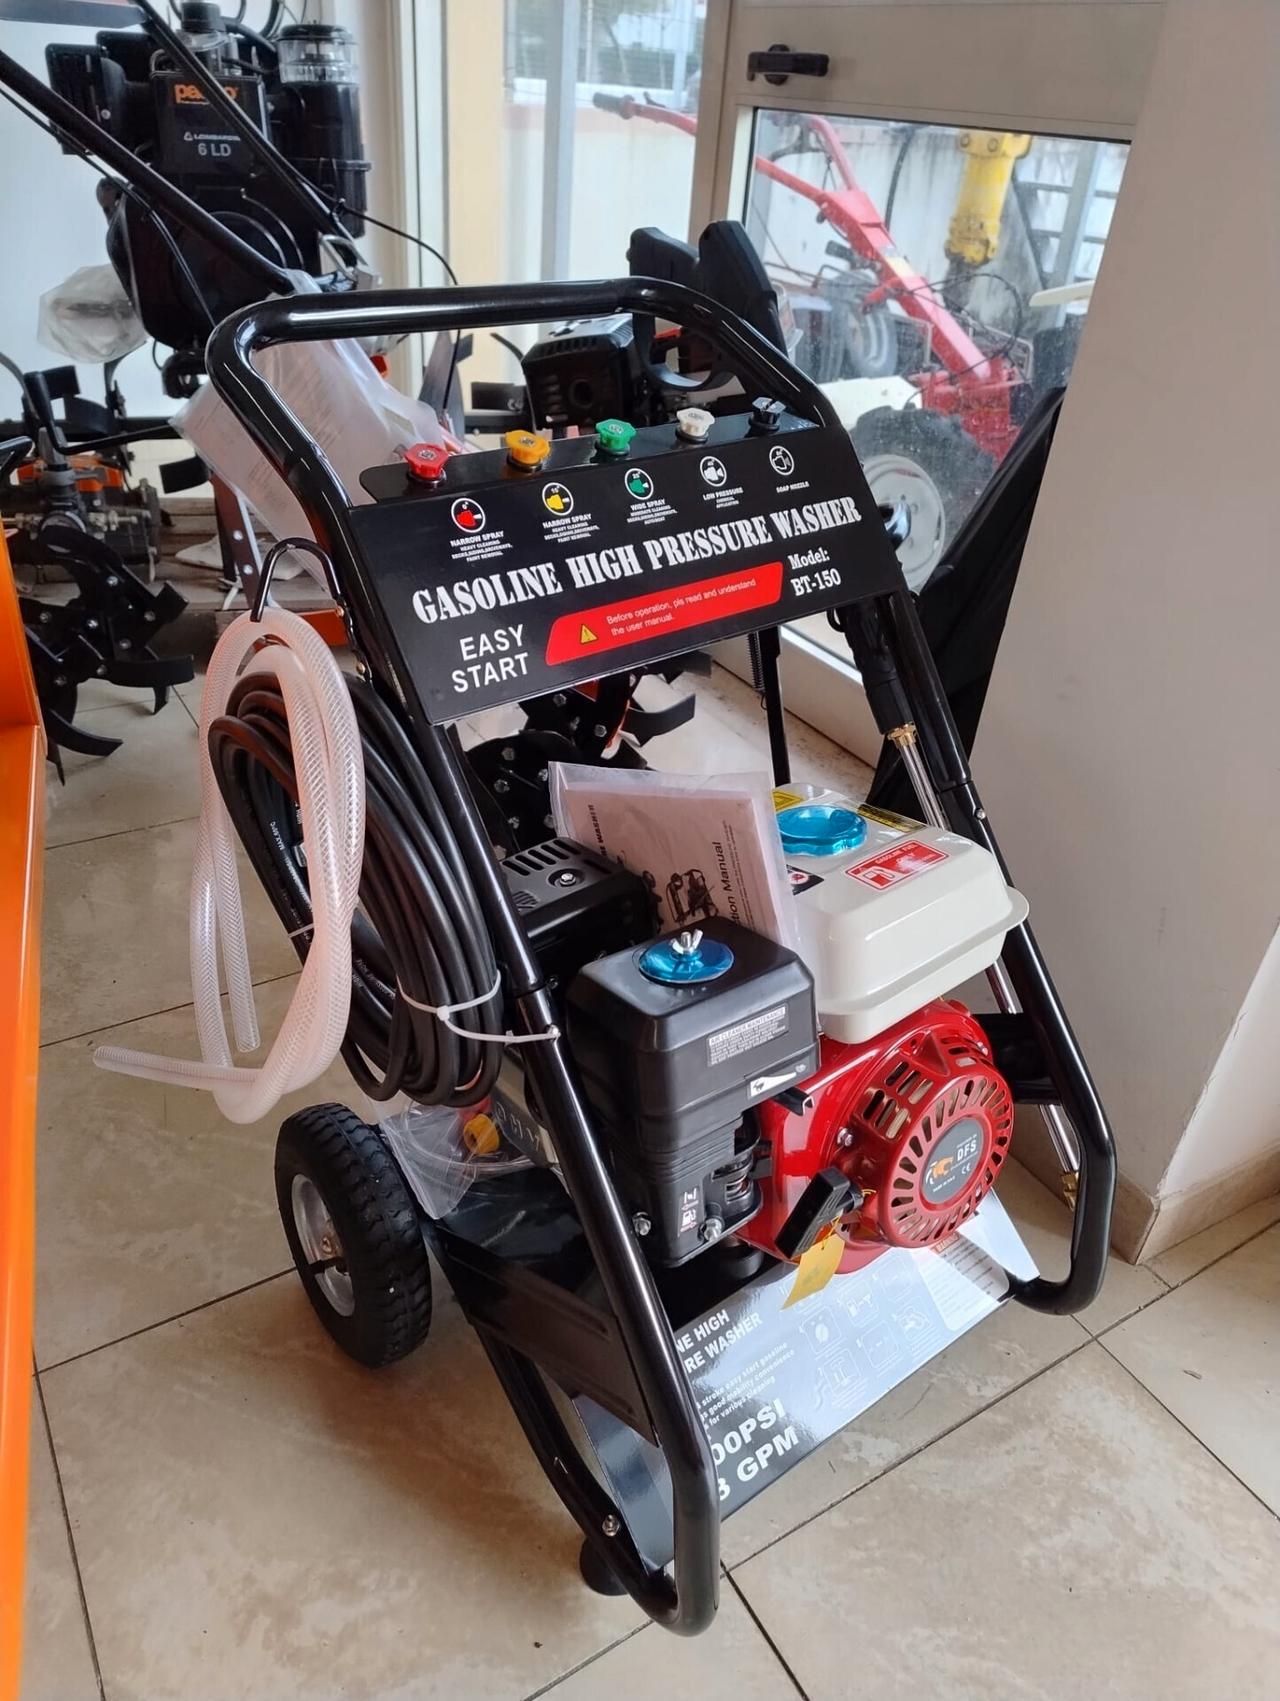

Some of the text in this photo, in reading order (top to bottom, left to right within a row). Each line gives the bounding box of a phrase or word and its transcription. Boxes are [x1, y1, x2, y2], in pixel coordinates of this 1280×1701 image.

[198, 142, 232, 157] 6 LD
[702, 487, 744, 501] LOW PRESSURE
[776, 485, 790, 494] SOAP
[630, 498, 666, 512] WIDE SPRAY
[542, 513, 592, 529] NARROW SPRAY
[449, 530, 505, 548] NARROW SPRAY
[459, 544, 477, 552] HEAVY
[412, 496, 862, 624] GASOLINE HIGH PRESSURE WASHER
[787, 546, 831, 570] Model:
[790, 567, 842, 597] BT-150
[606, 612, 634, 625] Before
[673, 597, 685, 609] pls
[685, 593, 703, 604] read
[703, 588, 718, 599] and
[717, 577, 757, 595] understand
[611, 612, 675, 637] the user manual.
[459, 624, 524, 662] EASY
[451, 652, 529, 694] START
[711, 841, 733, 893] Manual
[957, 1139, 977, 1161] DFS
[693, 1309, 731, 1342] HIGH
[704, 1311, 764, 1359] WASHER
[702, 1388, 724, 1407] stroke
[709, 1397, 727, 1414] good
[709, 1414, 720, 1426] for
[720, 1397, 746, 1418] various
[736, 1425, 800, 1482] GPM
